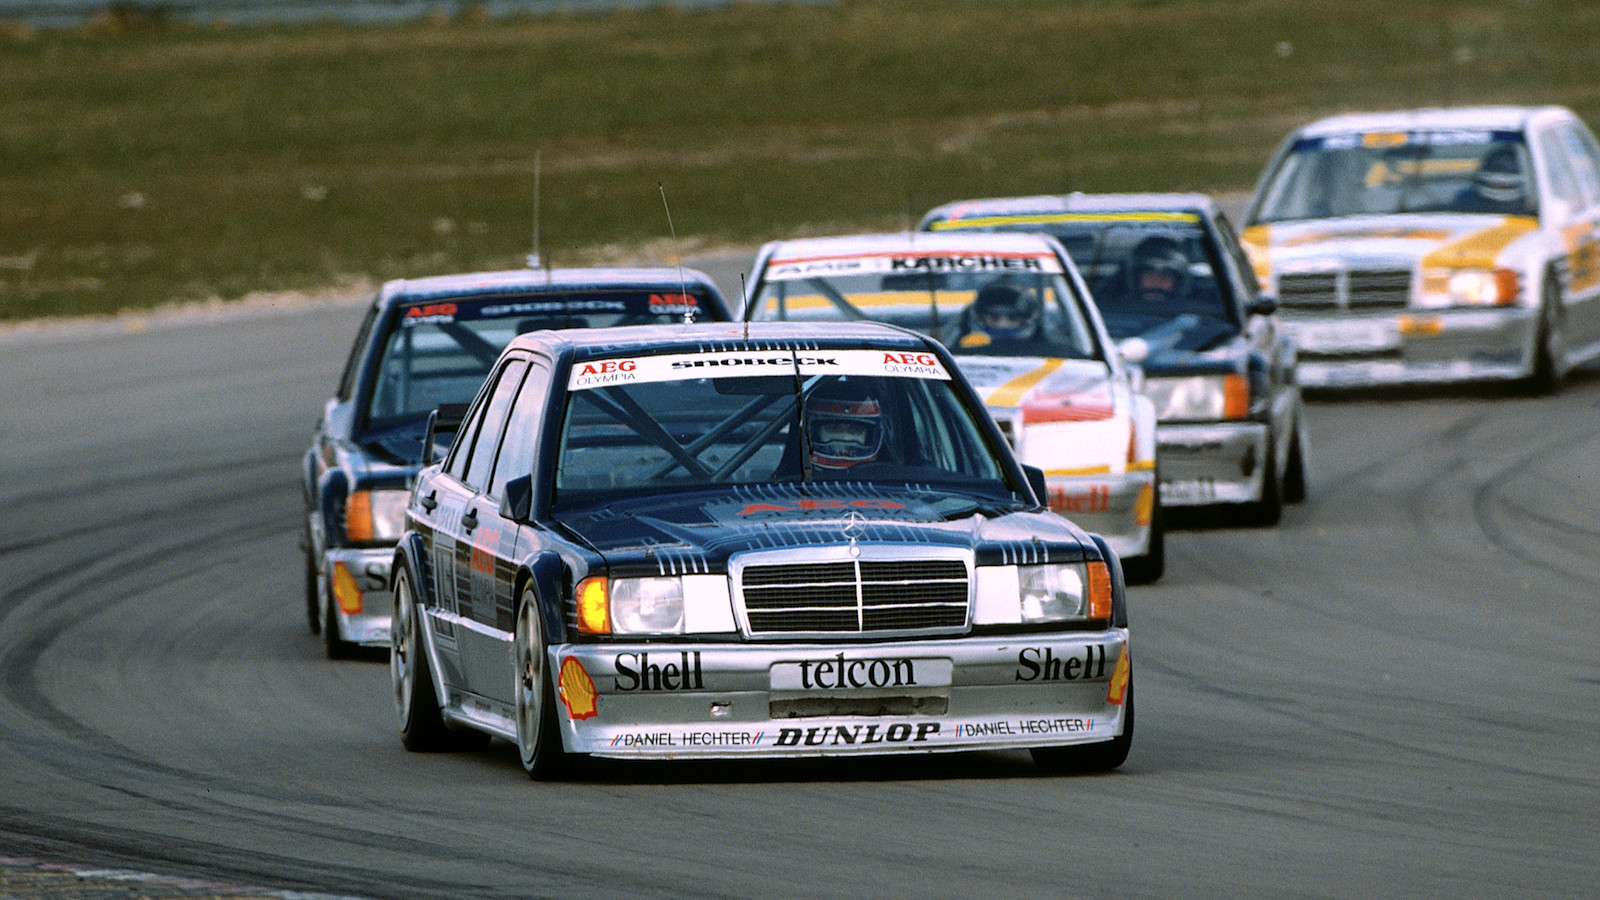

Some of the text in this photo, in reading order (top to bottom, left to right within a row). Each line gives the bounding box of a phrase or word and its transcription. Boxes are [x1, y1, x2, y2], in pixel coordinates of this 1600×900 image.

[579, 360, 637, 376] AEG
[883, 353, 936, 366] AEG
[884, 365, 941, 375] OLYMPIA
[577, 373, 636, 385] OLYMPIA
[1048, 484, 1109, 512] hell
[735, 499, 907, 515] AEG
[614, 651, 705, 691] Shell
[799, 652, 917, 689] telcon
[1015, 645, 1106, 681] Shell
[772, 723, 941, 746] DUNLOP
[965, 719, 1085, 737] DANIEL HECHTER
[624, 731, 751, 746] DANIEL HECHTER
